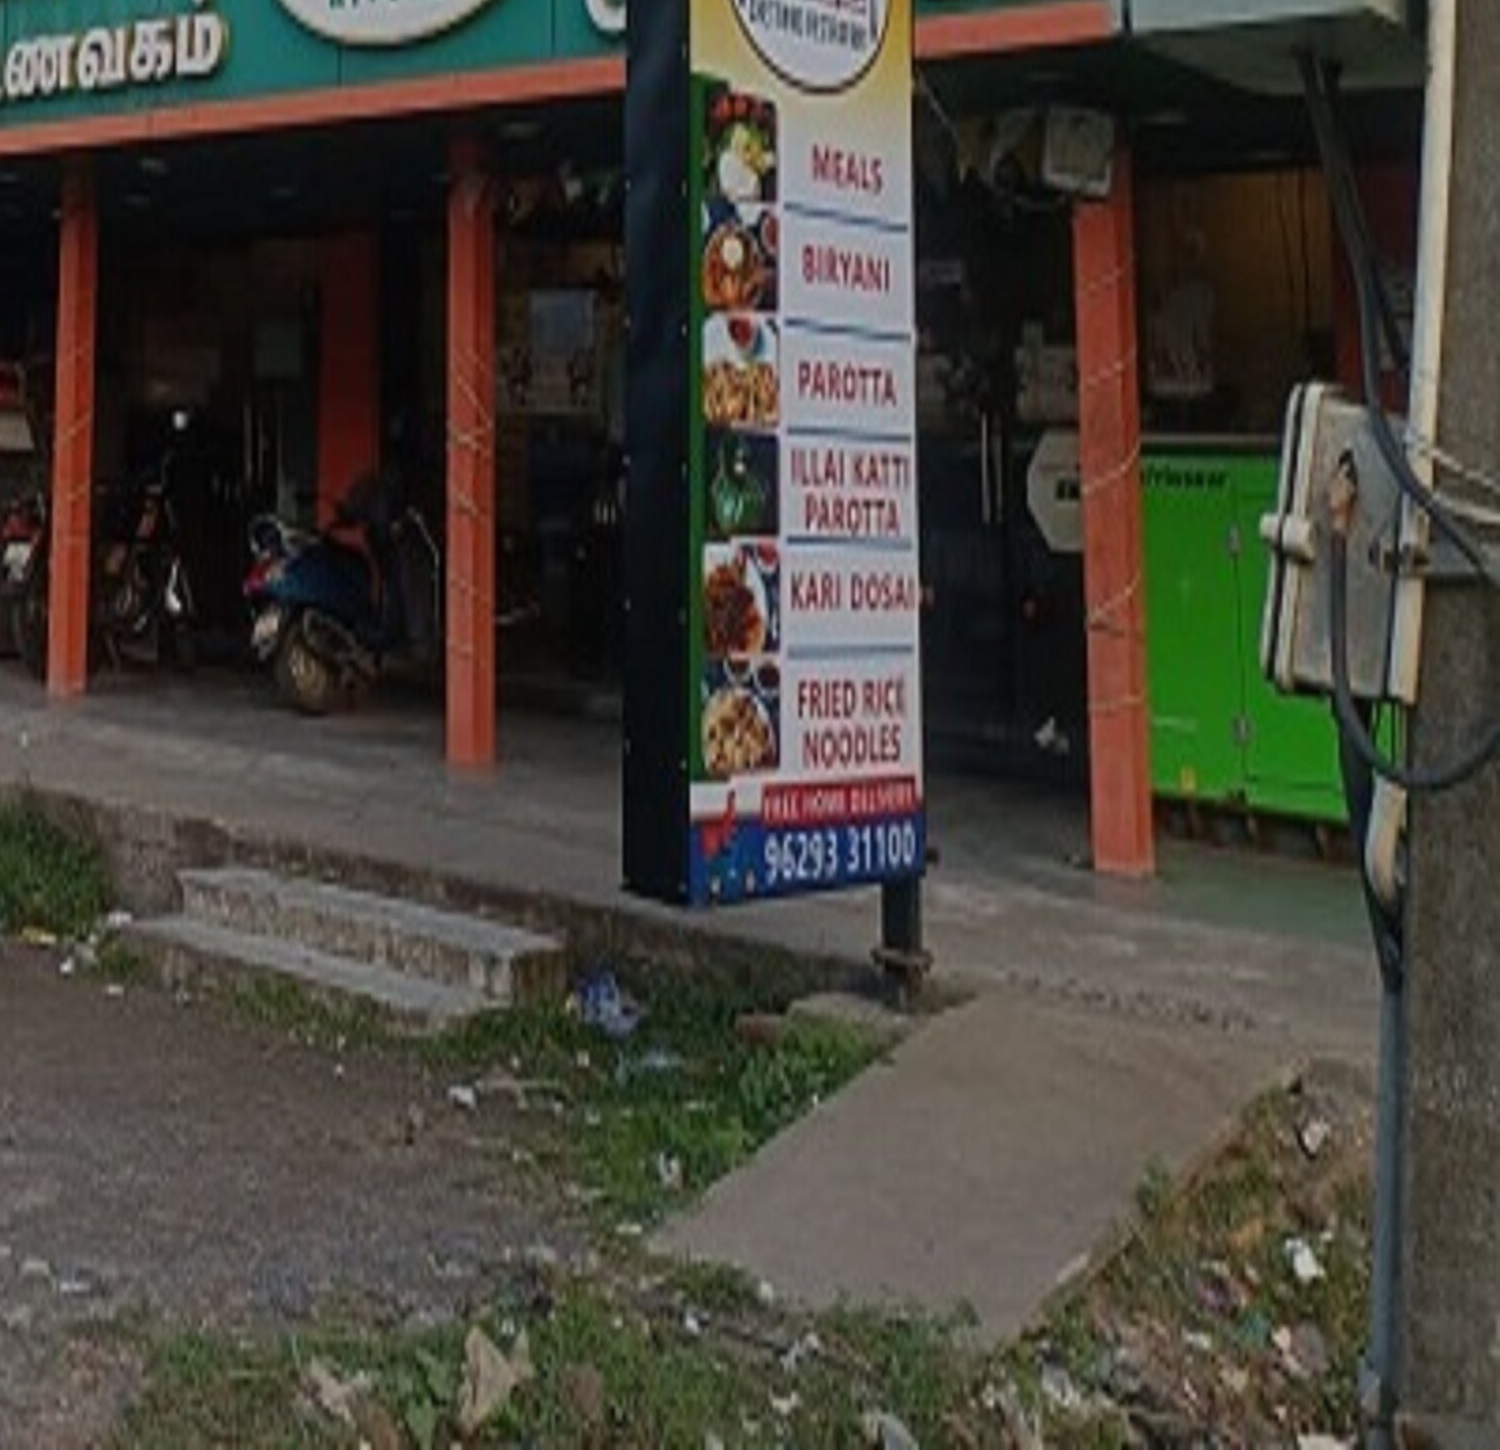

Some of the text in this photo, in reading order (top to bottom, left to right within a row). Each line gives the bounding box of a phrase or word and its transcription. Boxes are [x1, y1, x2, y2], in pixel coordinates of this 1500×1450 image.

[812, 144, 883, 193] MEALS
[802, 244, 891, 292] BIRYANI
[798, 357, 897, 408] PAROTTA
[790, 448, 910, 490] ILLAI KATTI
[805, 493, 901, 536] PAROTTA
[790, 569, 916, 611] KARI DOSAI
[798, 674, 906, 719] FRIED RICE
[802, 725, 902, 769] NOODLES
[764, 820, 916, 886] 96293 31100
